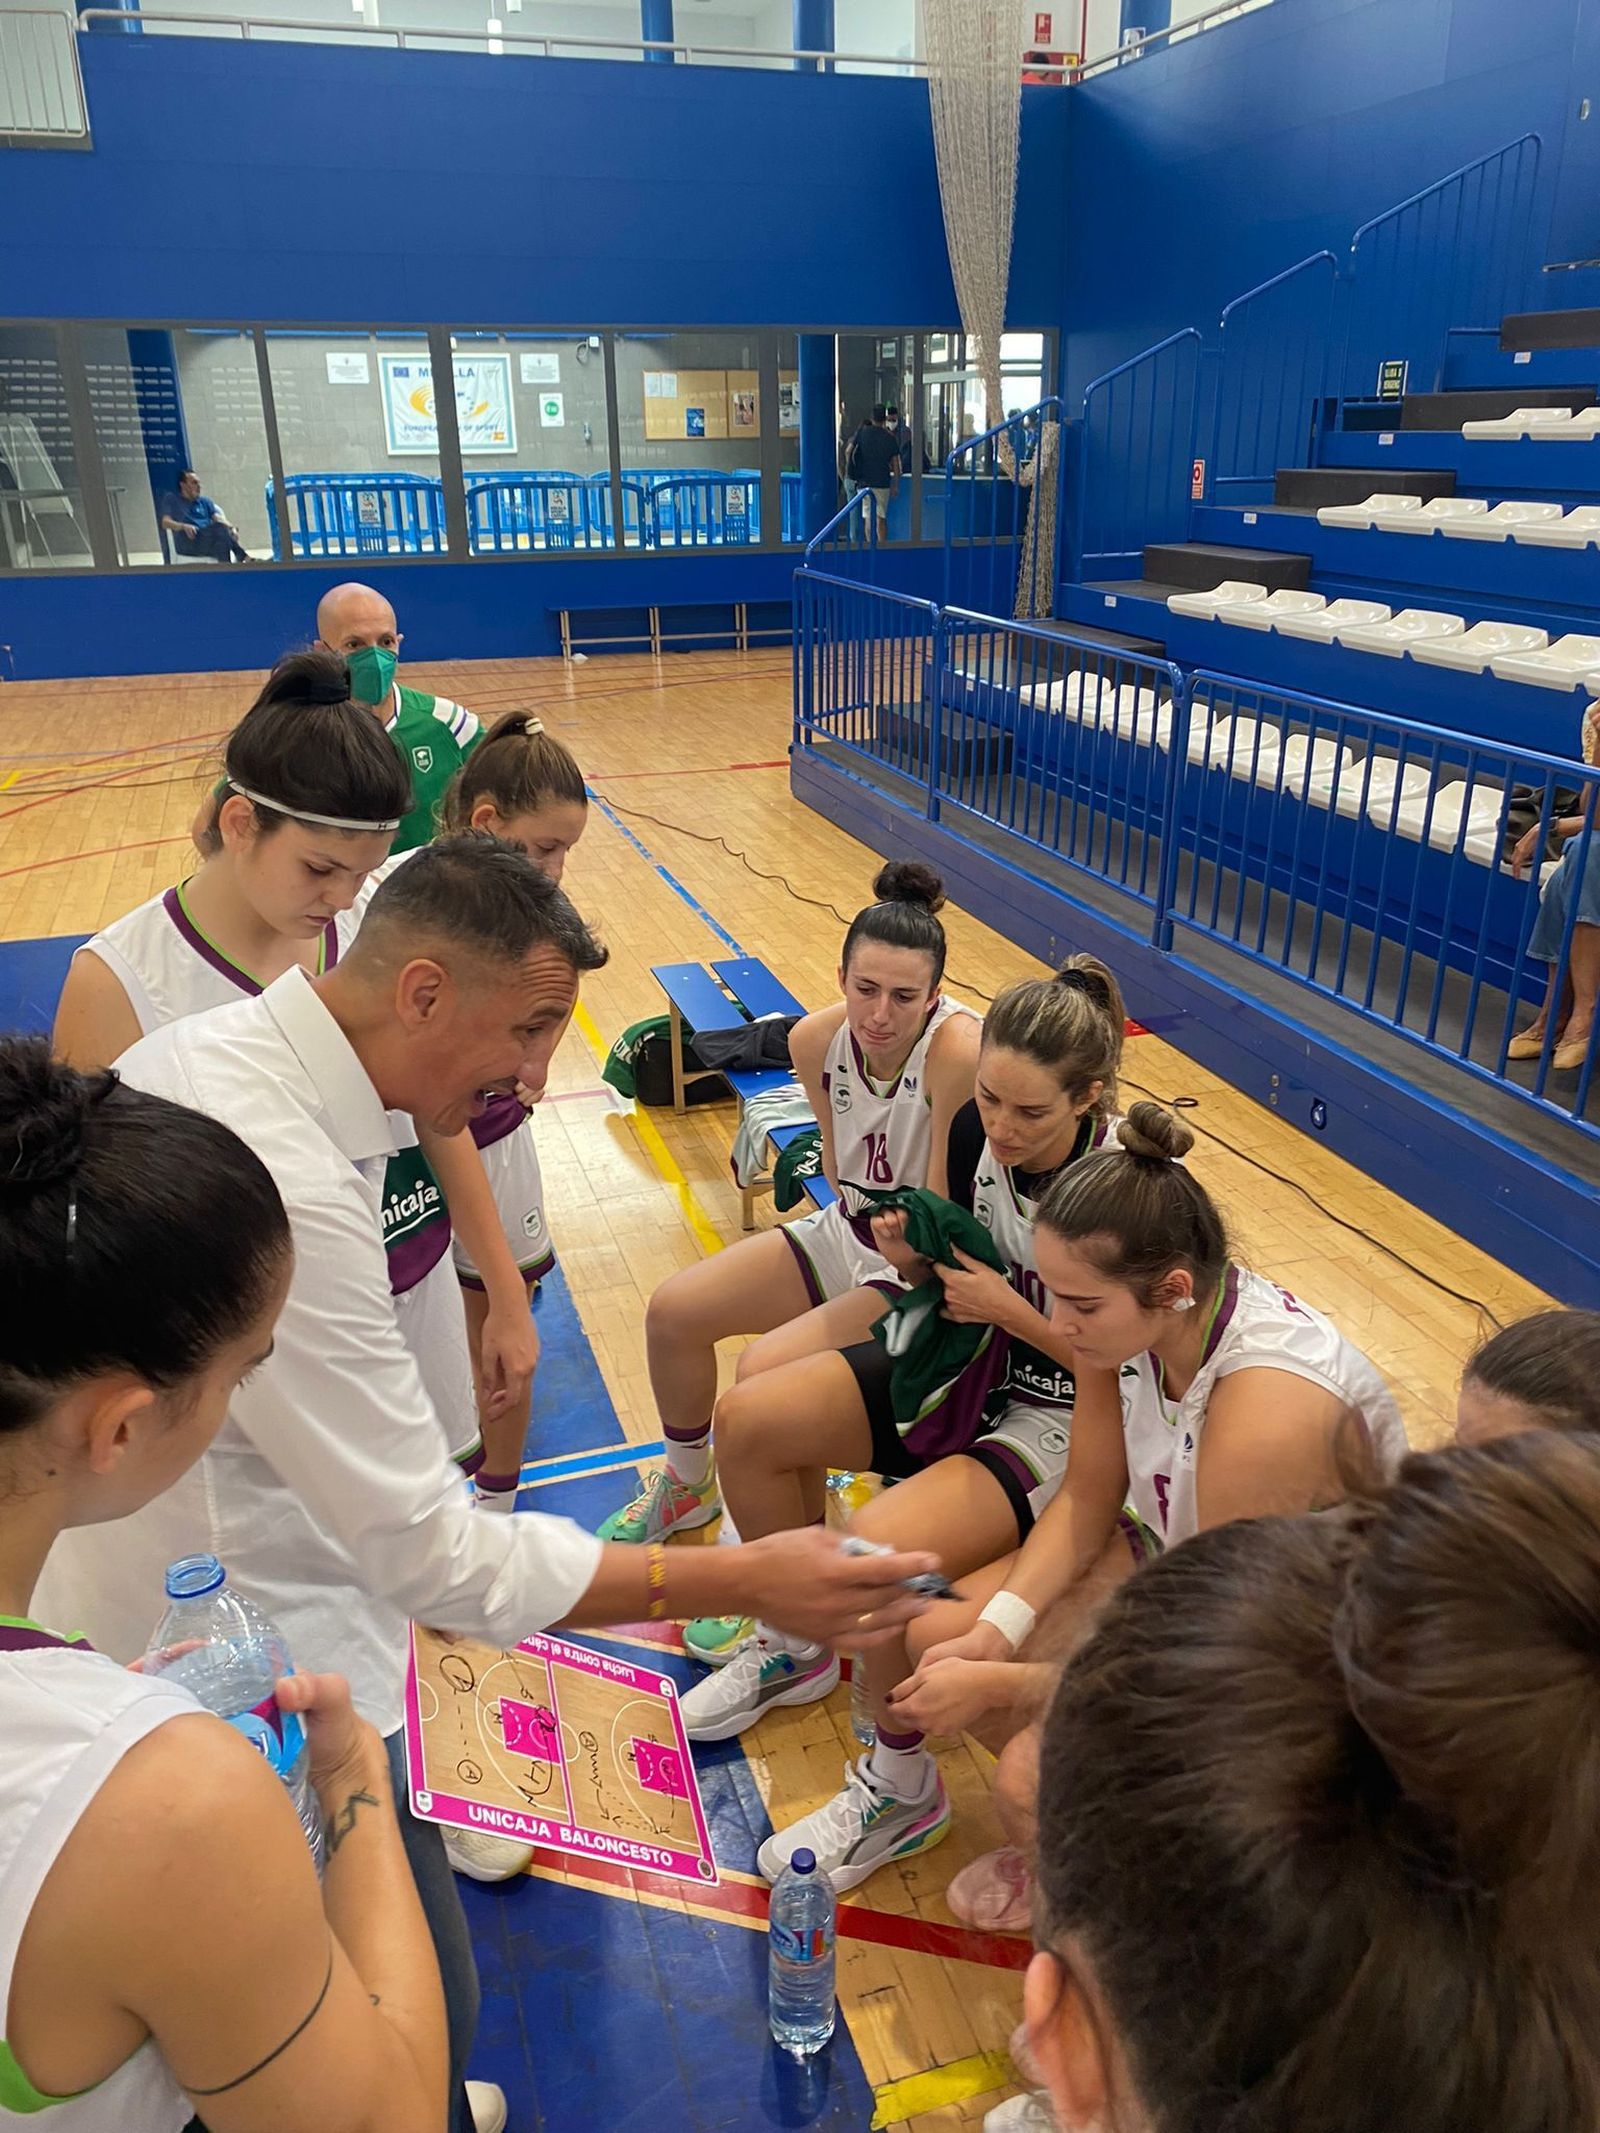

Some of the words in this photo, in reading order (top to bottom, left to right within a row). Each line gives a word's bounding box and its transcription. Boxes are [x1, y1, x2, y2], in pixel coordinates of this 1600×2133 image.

[862, 1131, 893, 1183] 18
[381, 1179, 440, 1229] nicaja
[1014, 1364, 1075, 1397] nicaja
[522, 1635, 549, 1652] cán
[550, 1642, 562, 1656] el
[563, 1646, 601, 1668] contra
[602, 1659, 636, 1683] Lucha
[468, 1805, 552, 1839] UNICAJA
[559, 1826, 673, 1867] BALONCESTO
